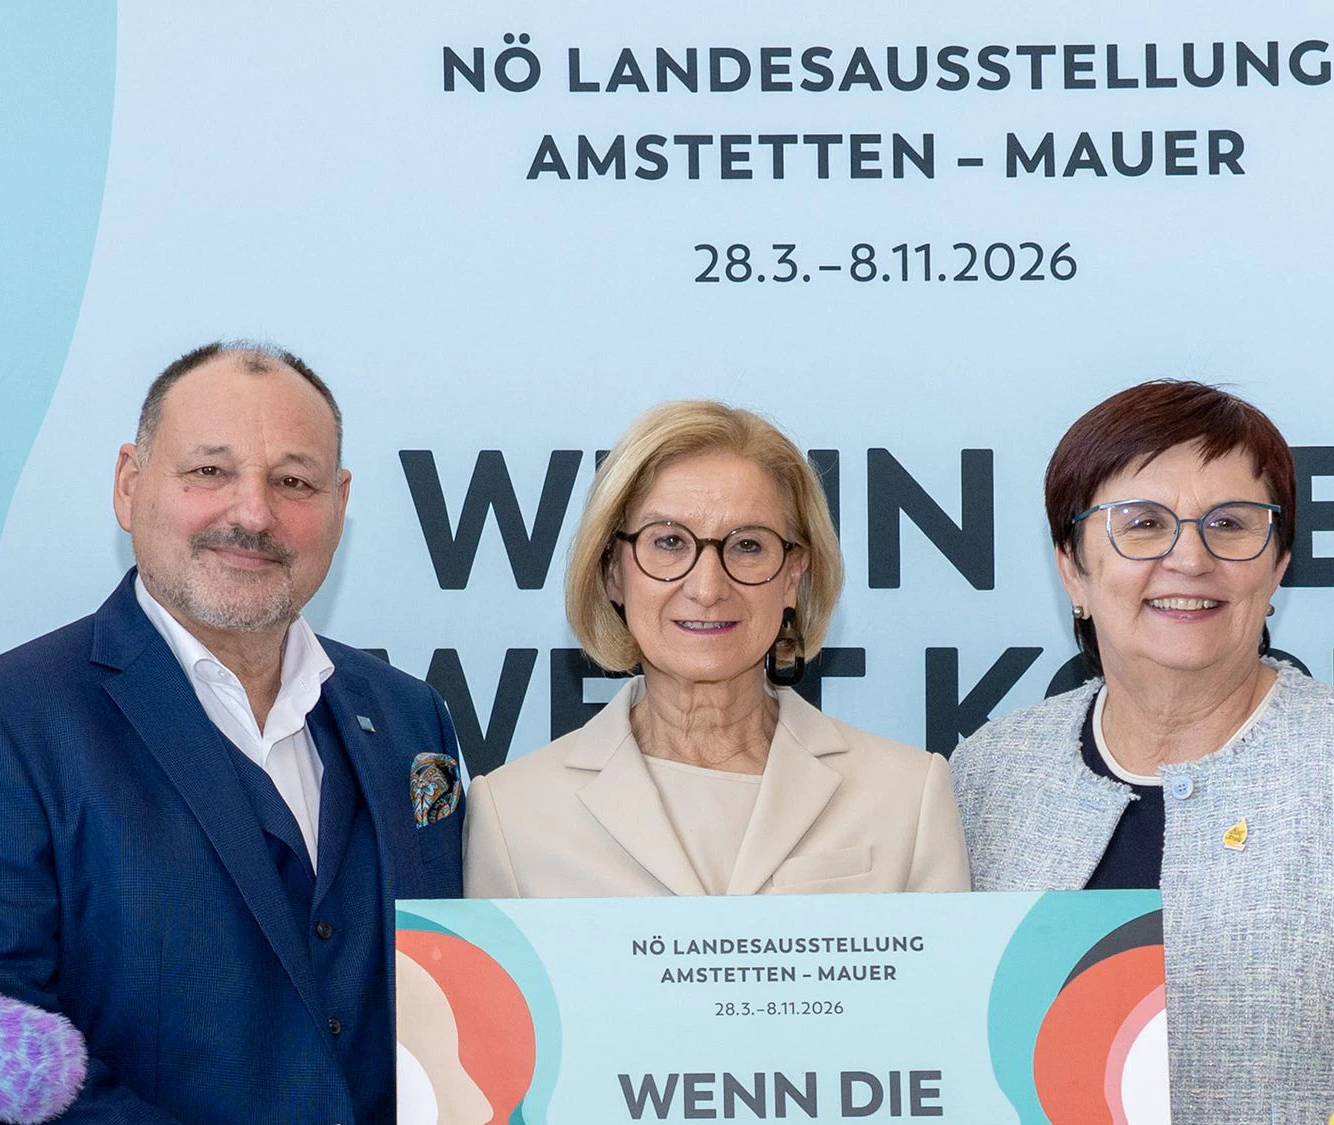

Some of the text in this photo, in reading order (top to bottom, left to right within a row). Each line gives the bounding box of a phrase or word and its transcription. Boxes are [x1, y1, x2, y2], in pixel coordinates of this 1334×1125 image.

[442, 33, 1333, 93] NÖ LANDESAUSSTELLUNG
[526, 133, 935, 181] AMSTETTEN
[1006, 129, 1246, 178] MAUER
[633, 936, 924, 956] NÖ LANDESAUSSTELLUNG
[660, 967, 796, 984] AMSTETTEN
[818, 965, 897, 982] MAUER
[617, 1070, 944, 1120] WENN DIE
